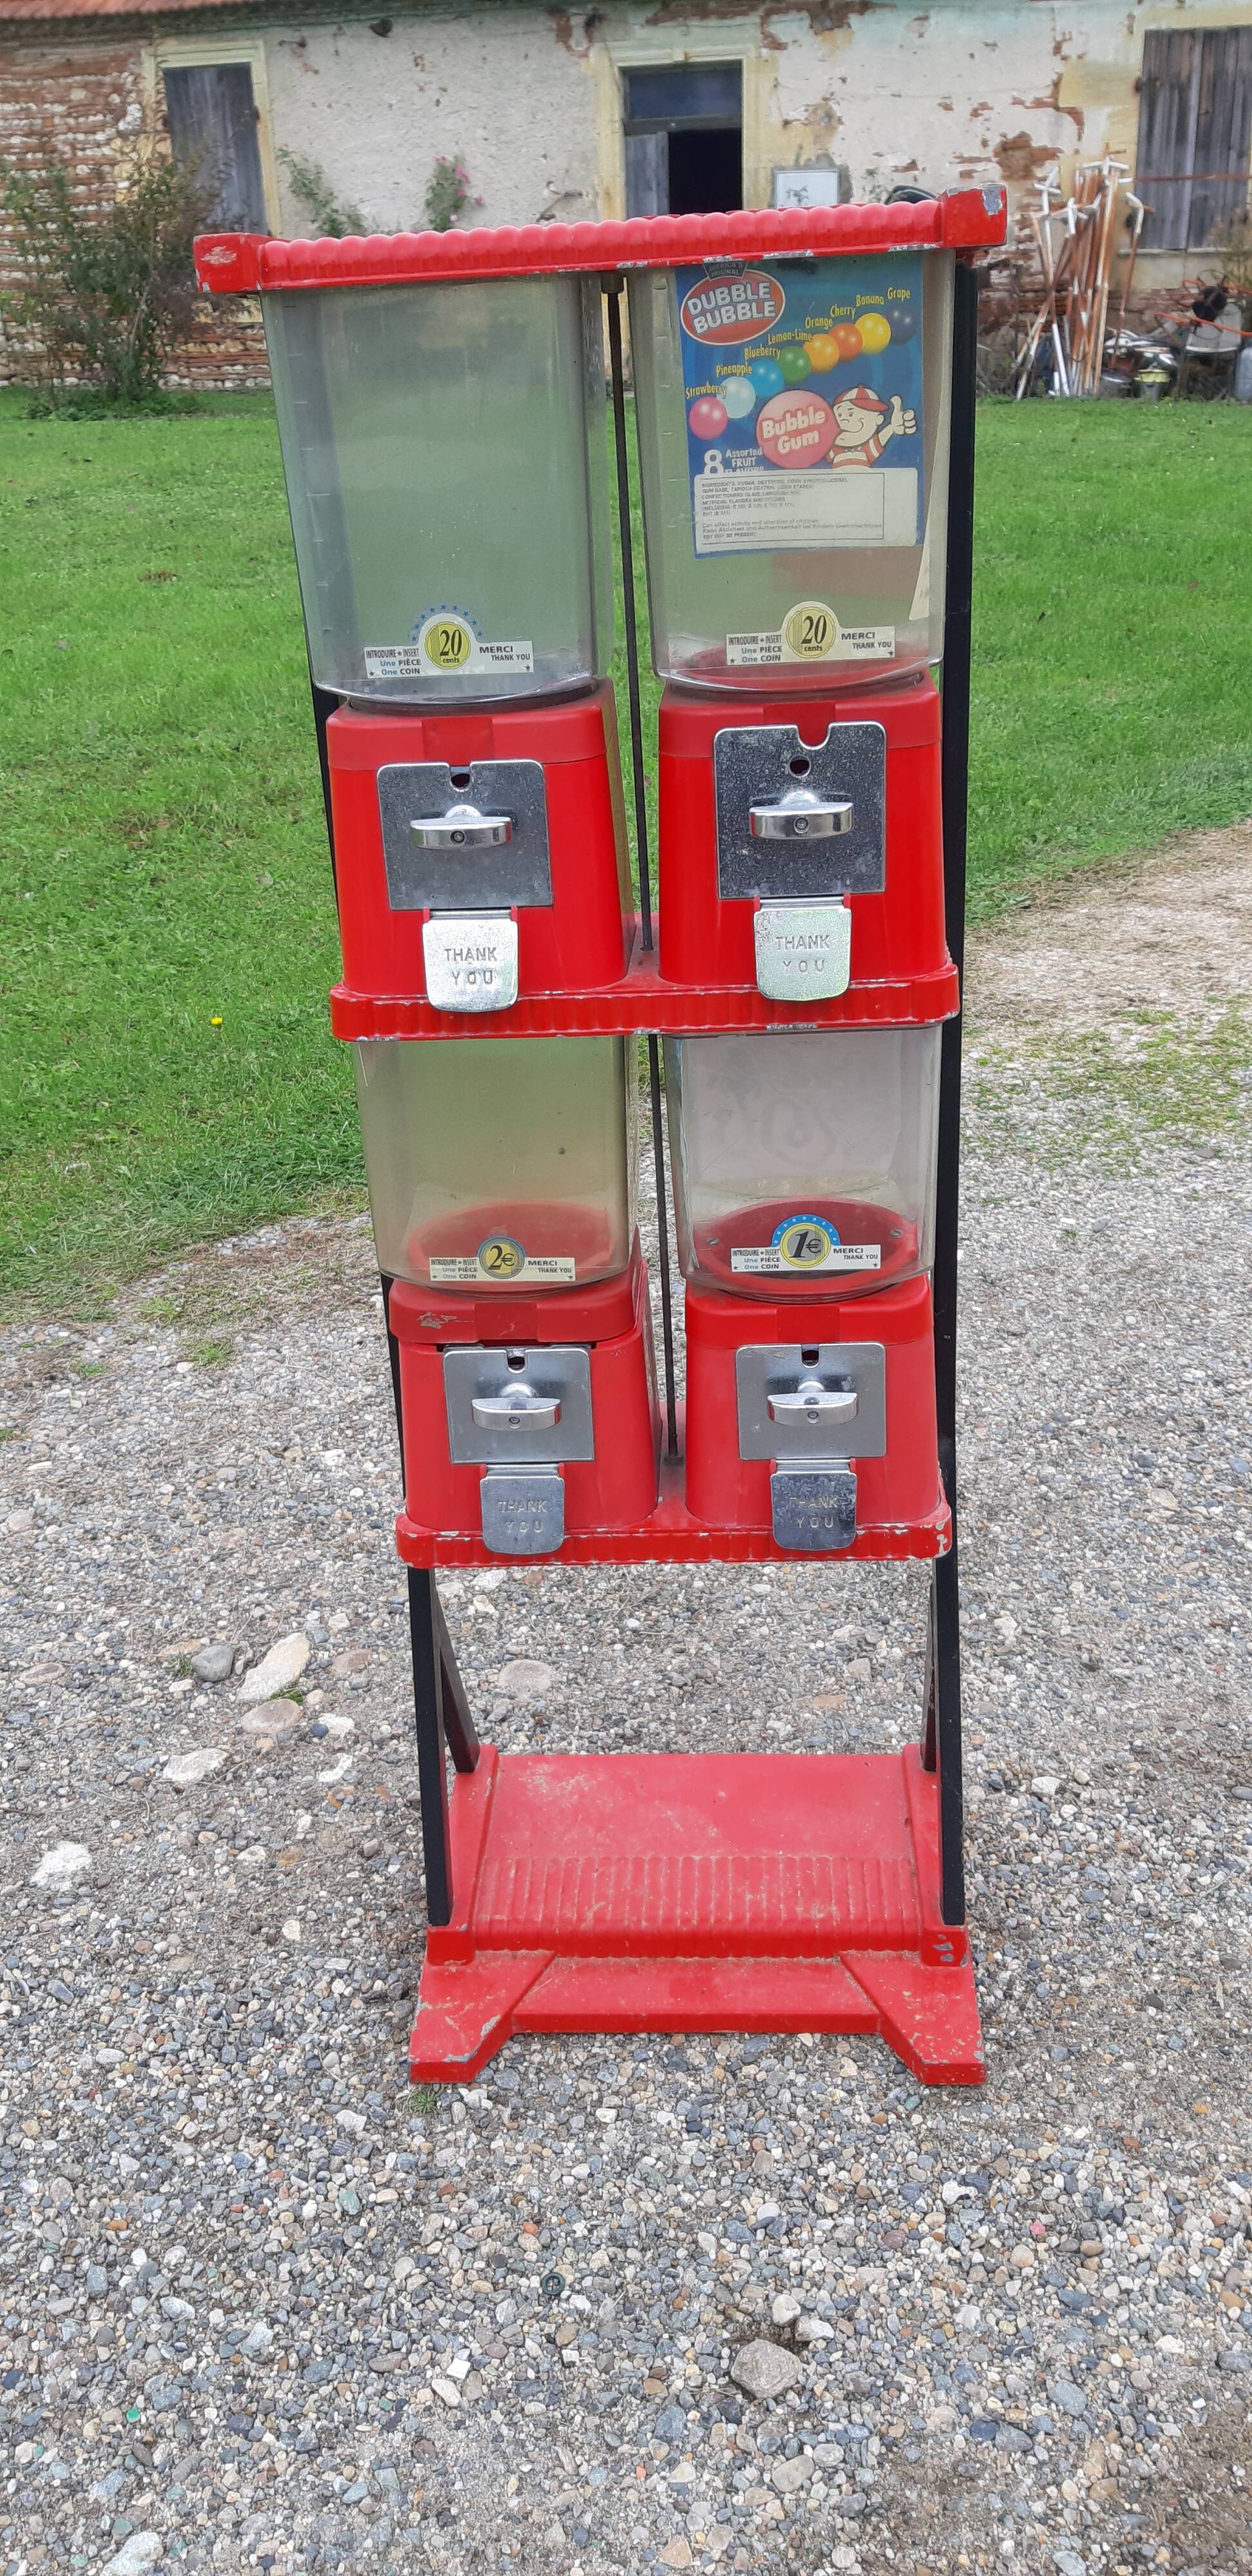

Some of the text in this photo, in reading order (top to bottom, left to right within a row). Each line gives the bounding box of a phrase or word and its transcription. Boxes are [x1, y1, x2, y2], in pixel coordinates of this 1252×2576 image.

[687, 282, 771, 316] DUBBLE
[856, 294, 884, 307] Banana
[887, 287, 911, 301] Grape
[692, 301, 775, 334] BUBBLE
[830, 304, 855, 319] Cherry
[805, 317, 833, 328] Orange
[768, 328, 812, 345] Lemon-Lime
[744, 347, 781, 360] Blueberry
[716, 361, 752, 377] Pineapple
[686, 381, 727, 399] Strawberry
[762, 406, 826, 439] Bubble
[777, 430, 819, 454] Gum
[725, 446, 763, 458] Assorted
[704, 449, 724, 474] 8
[732, 457, 757, 468] FRUIT
[801, 615, 827, 644] 20
[841, 632, 875, 640] MERCI
[439, 629, 462, 657] 20
[728, 634, 782, 645] INTRODUIRE INSERT
[366, 649, 419, 658] INTRODUIRE INSERT
[760, 645, 782, 653] PIÈCE
[775, 934, 830, 950] THANK
[444, 947, 498, 962] THANK
[782, 960, 825, 974] YOU
[452, 970, 493, 985] YOU
[789, 1231, 821, 1258] 1€
[488, 1245, 515, 1270] 2€
[498, 1499, 547, 1513] THANK
[790, 1495, 839, 1508] THANK
[506, 1520, 544, 1533] YOU
[797, 1517, 834, 1528] YOU
